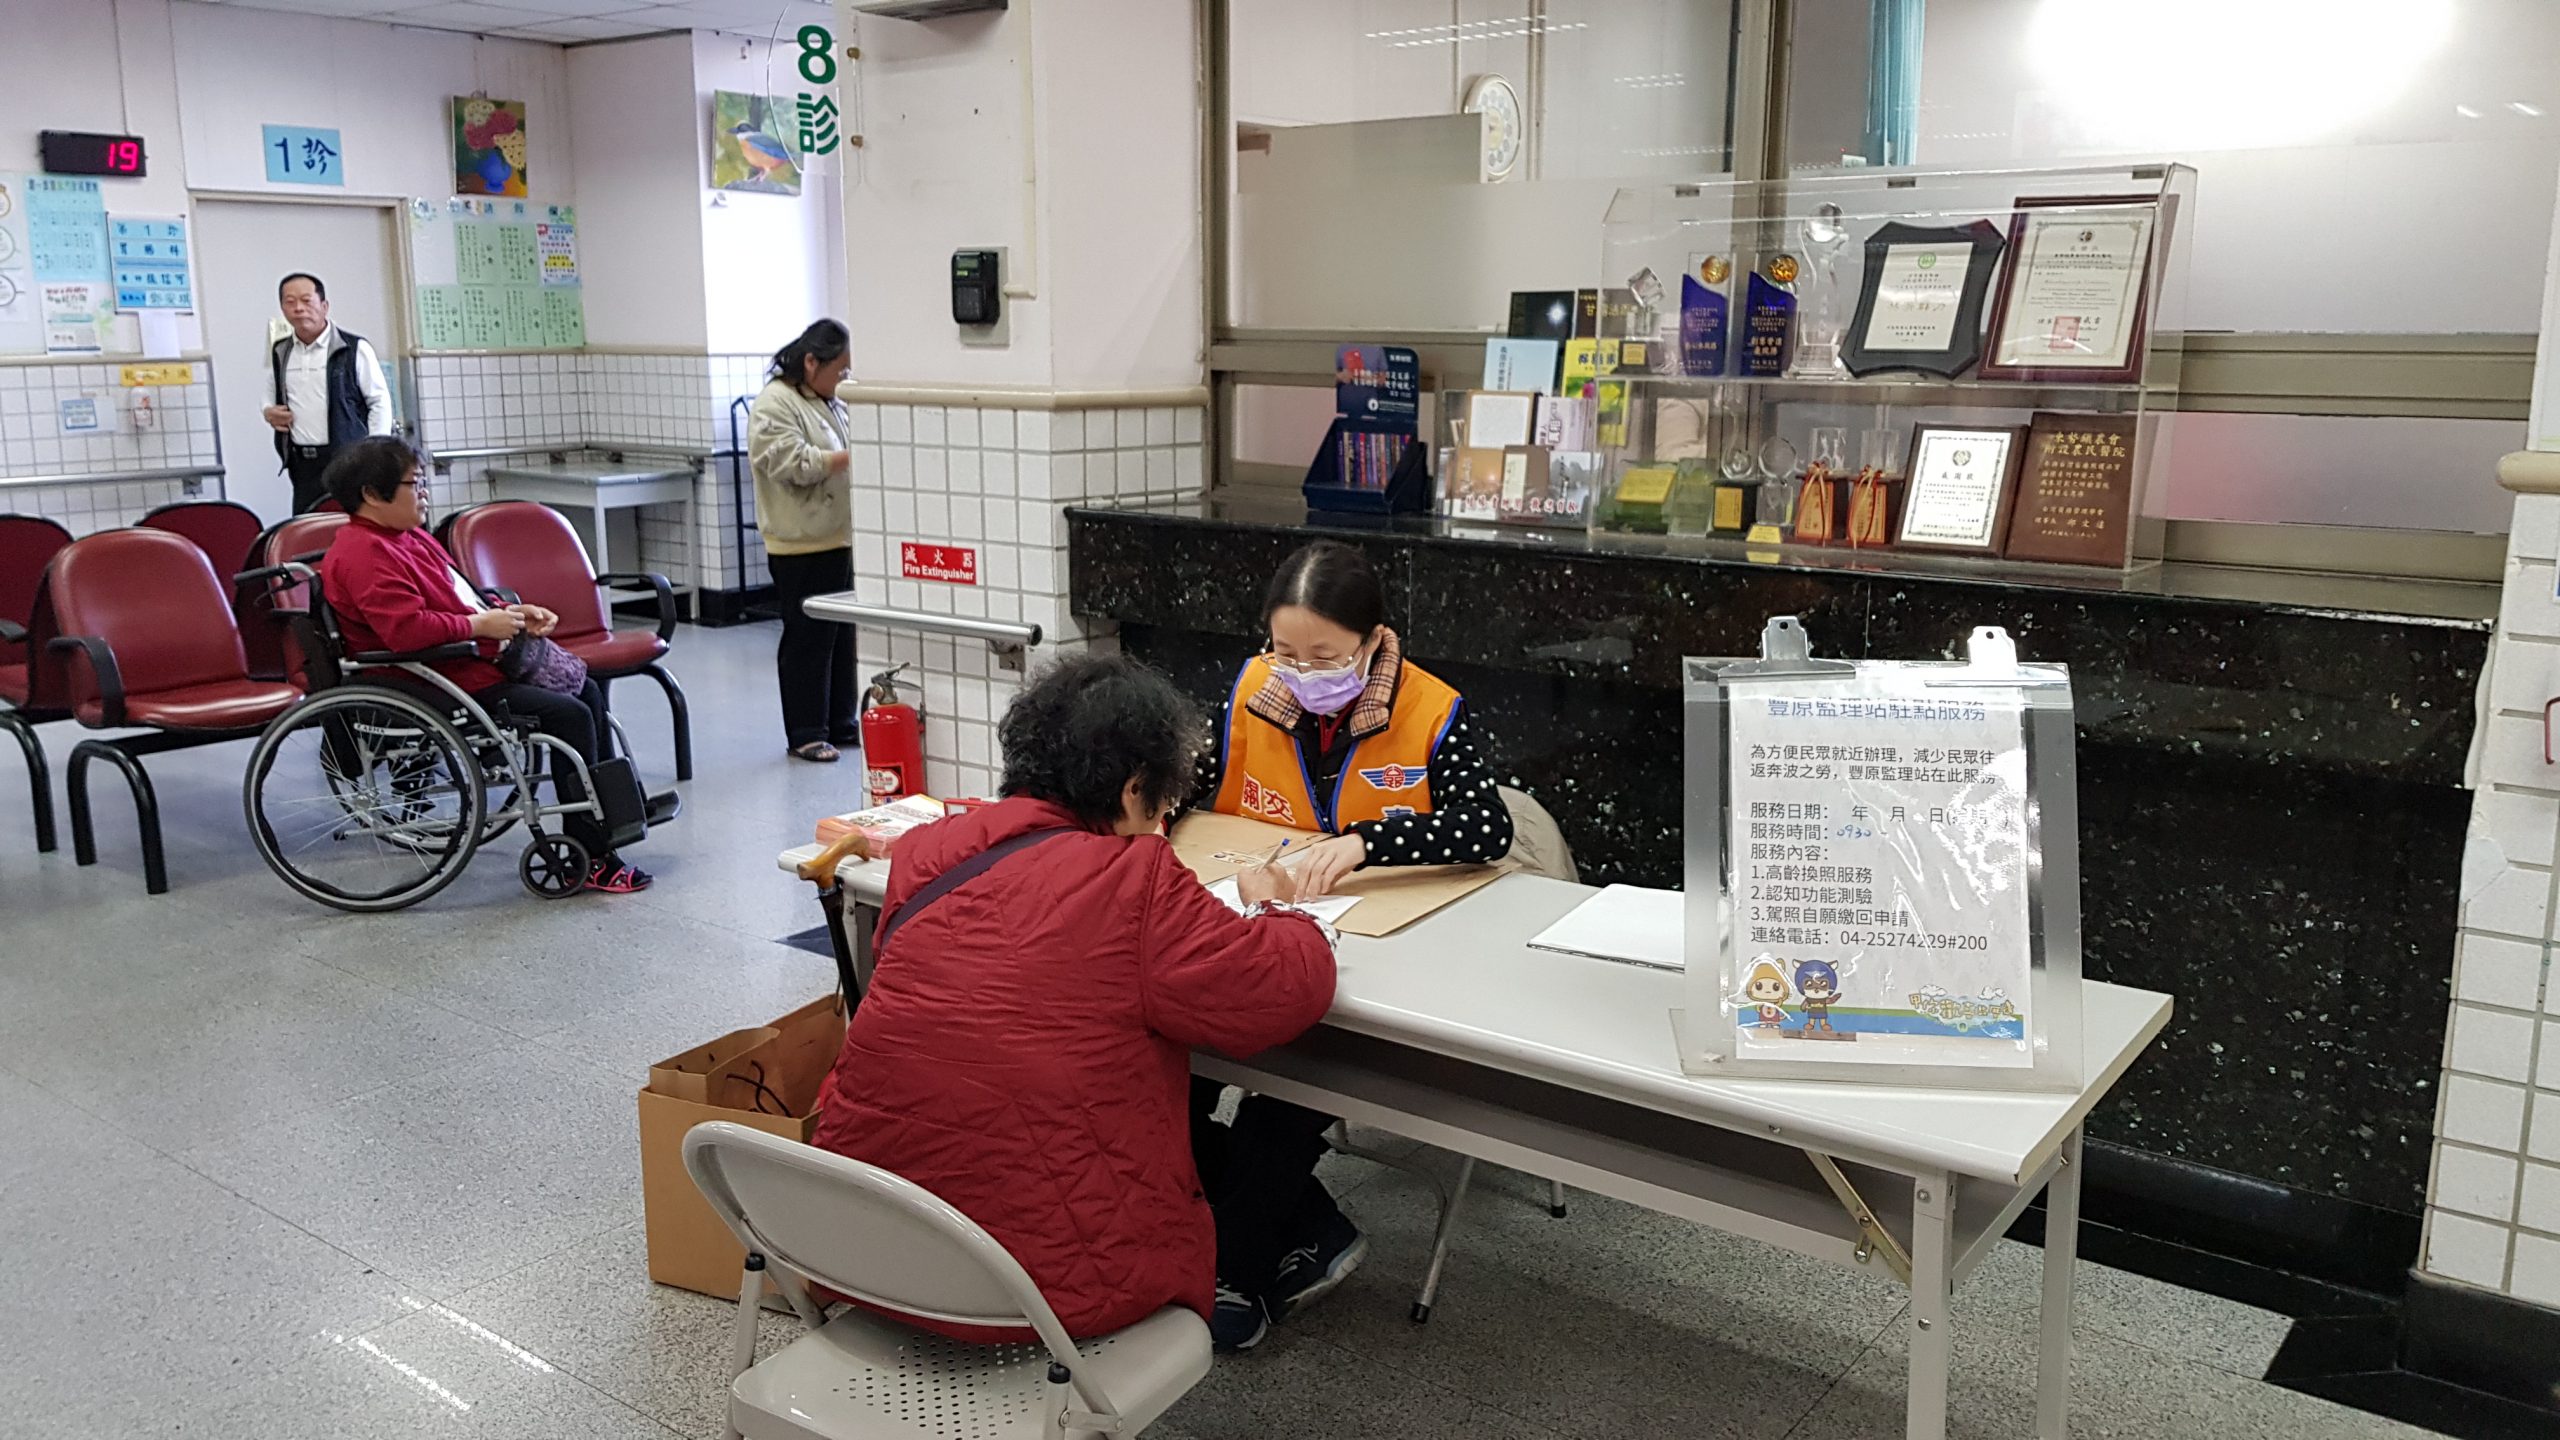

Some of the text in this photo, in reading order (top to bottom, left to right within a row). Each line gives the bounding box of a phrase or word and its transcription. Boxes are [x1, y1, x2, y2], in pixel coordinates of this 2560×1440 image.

[107, 141, 139, 171] 19
[904, 545, 973, 568] 滅火器
[904, 562, 974, 580] Fire Extinguisher
[1851, 805, 1870, 822] 年
[1889, 806, 1906, 824] 月
[1750, 864, 1873, 884] 1.高齡換照服務
[1750, 885, 1873, 905] 2.認知功能測驗
[1750, 905, 1909, 927] 3.駕照自願繳回申請
